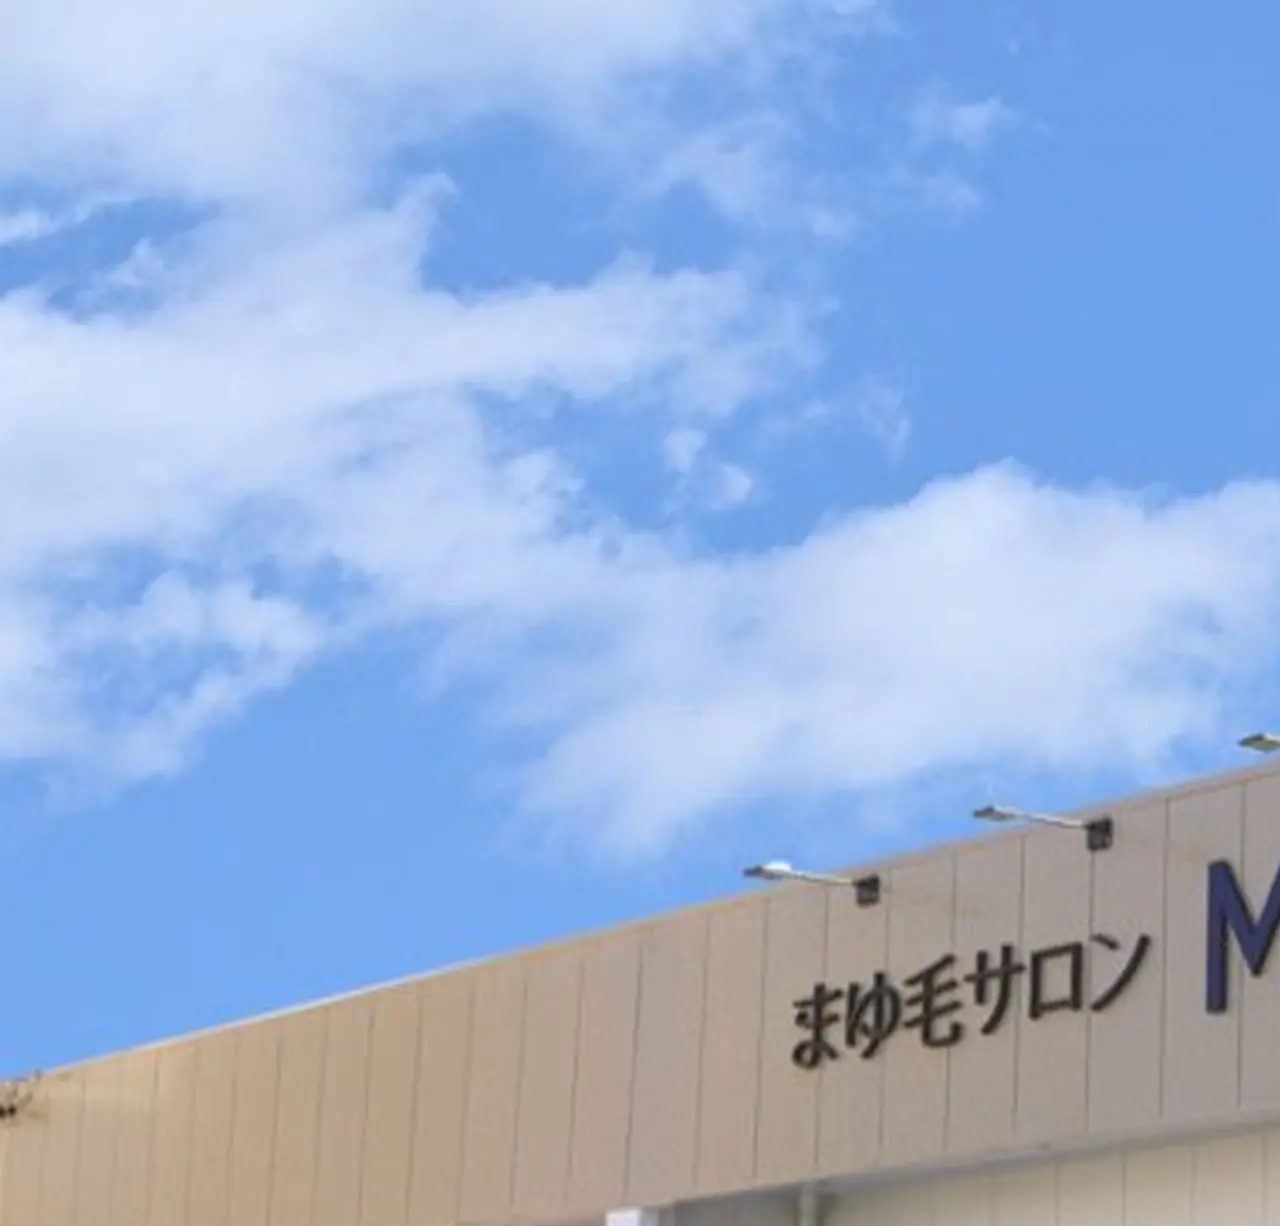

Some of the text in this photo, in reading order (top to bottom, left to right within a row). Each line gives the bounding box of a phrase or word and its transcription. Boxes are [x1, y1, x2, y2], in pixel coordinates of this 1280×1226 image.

[791, 931, 1153, 1071] まゆ毛サロン
